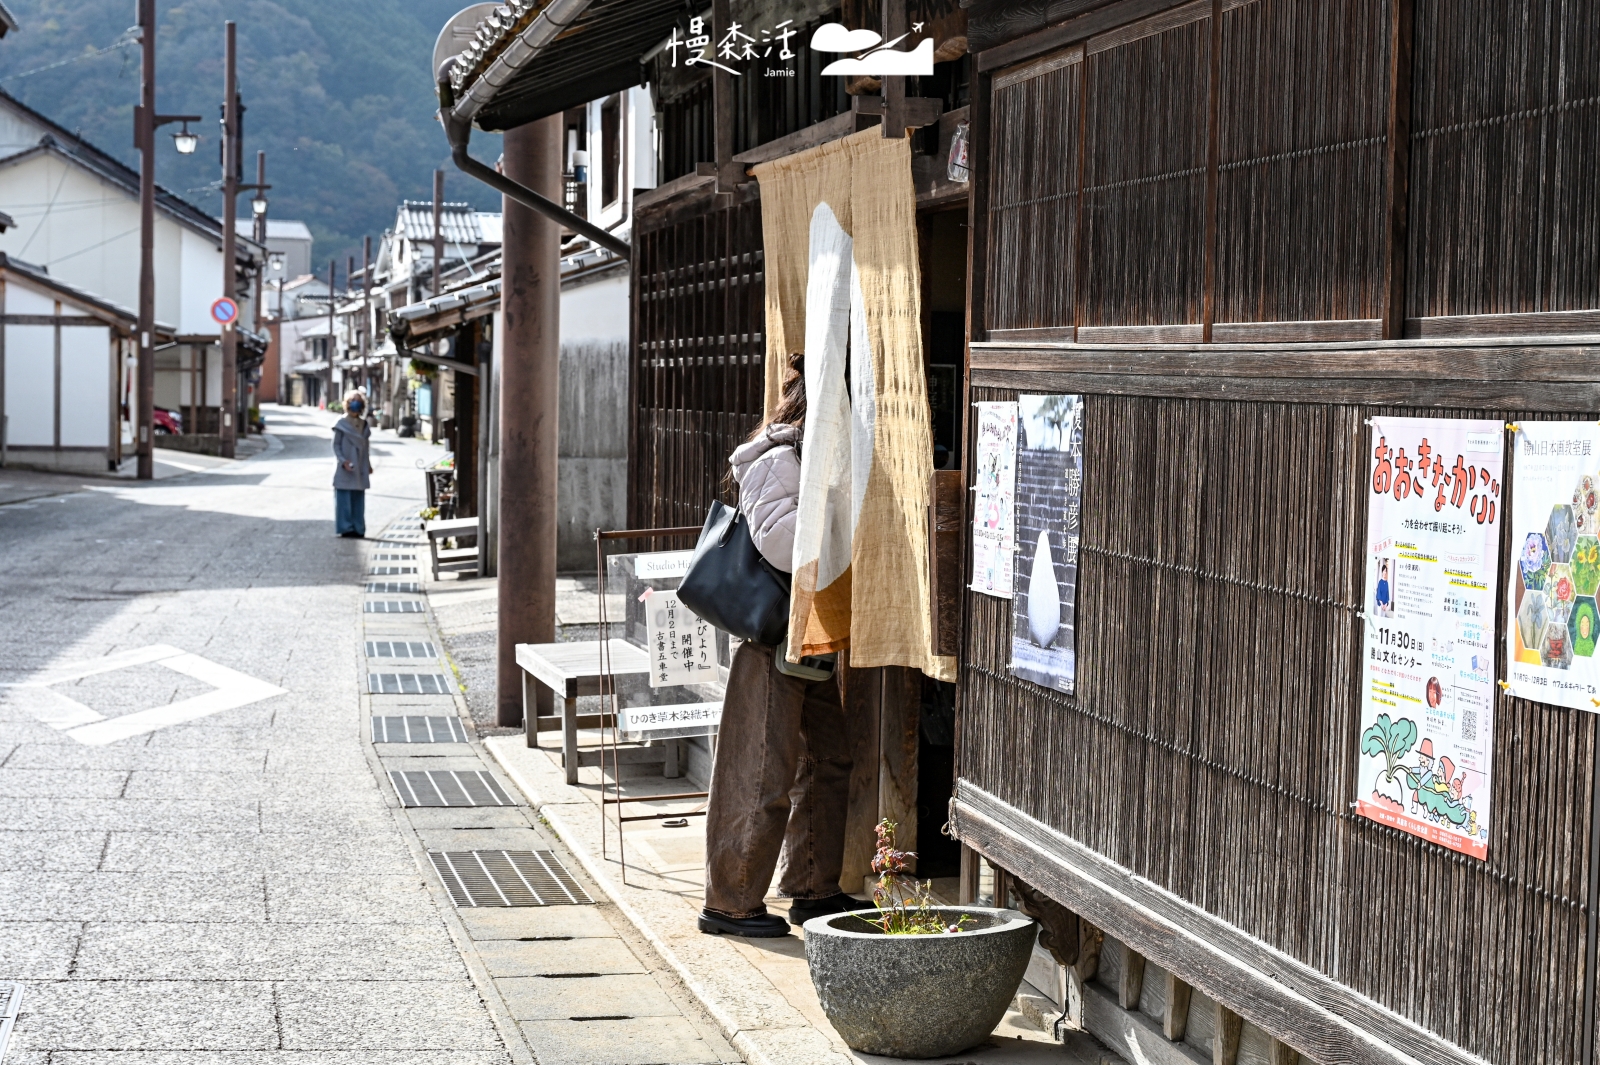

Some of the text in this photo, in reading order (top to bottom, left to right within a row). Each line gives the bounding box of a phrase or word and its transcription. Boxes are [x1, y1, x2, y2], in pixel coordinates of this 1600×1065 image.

[1372, 436, 1500, 525] おおきなかぶ
[646, 559, 675, 571] Studio
[664, 599, 678, 660] 12月2日まで
[681, 633, 694, 672] 開催中
[1370, 646, 1423, 669] 勝山文化センター
